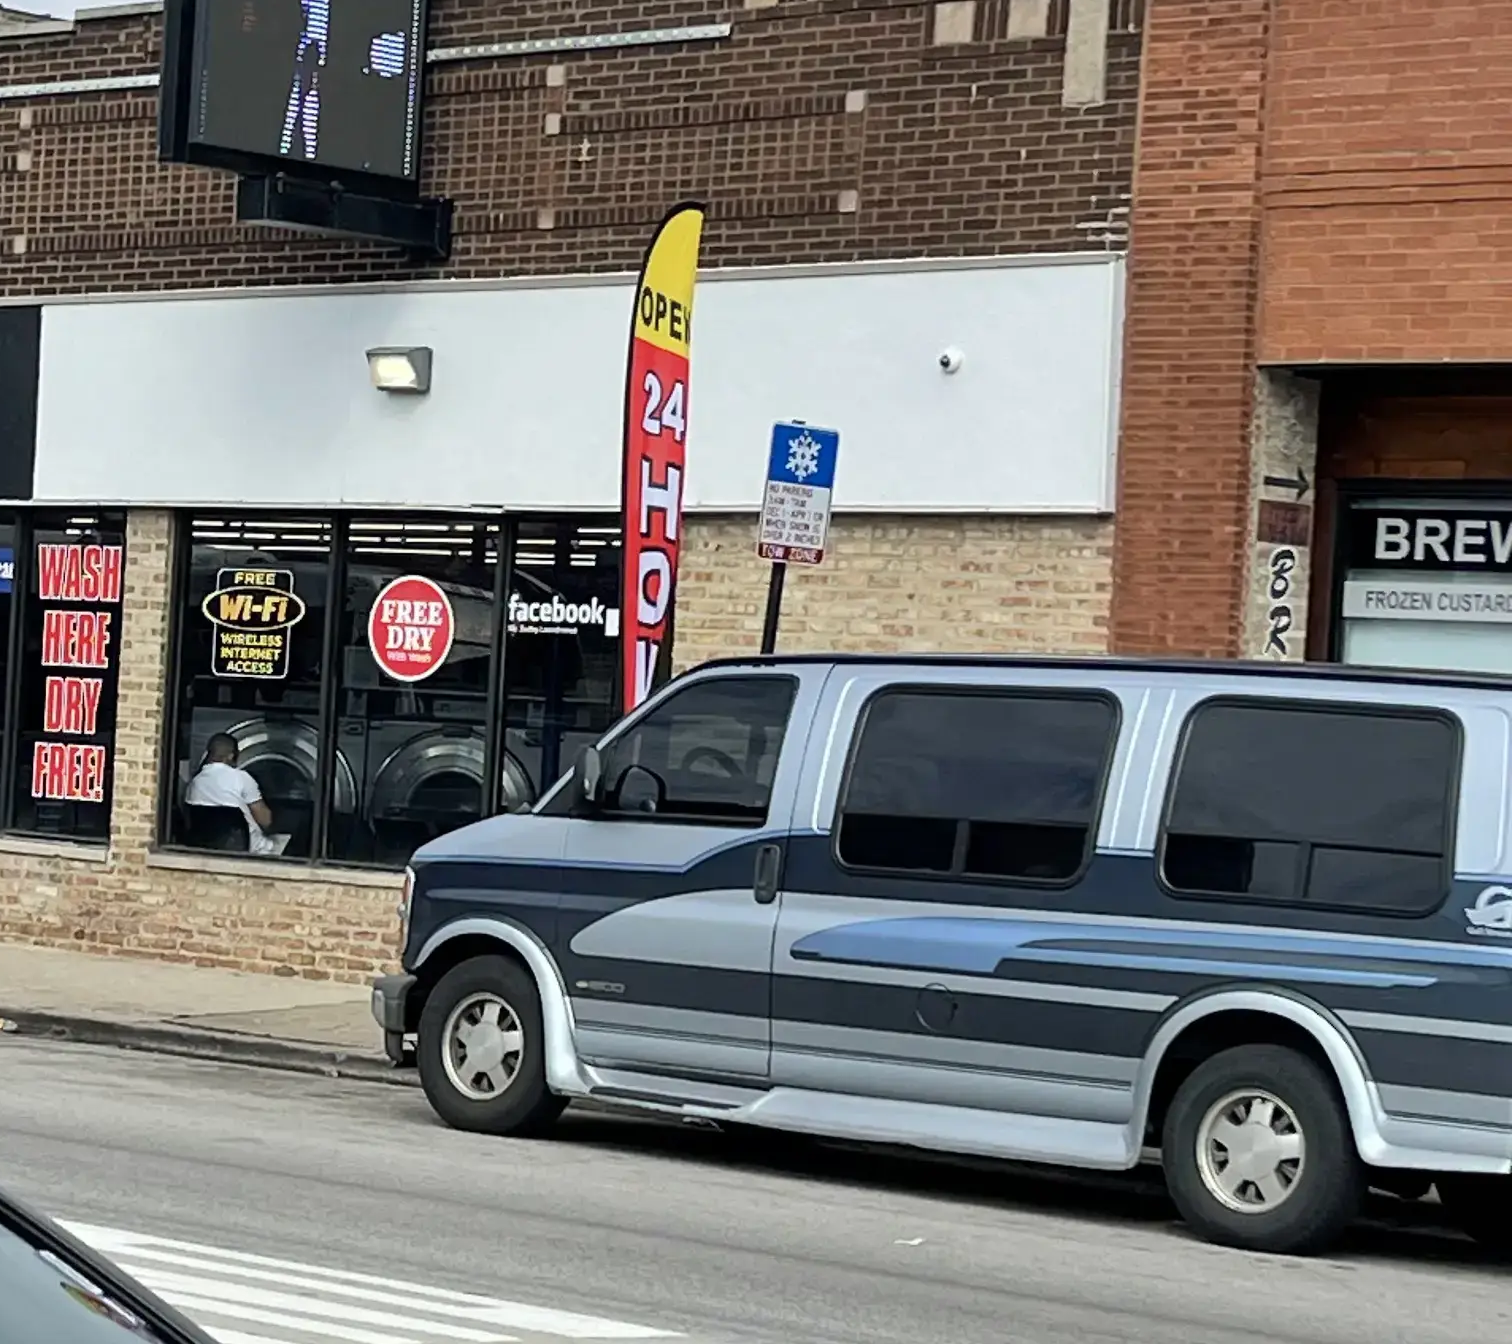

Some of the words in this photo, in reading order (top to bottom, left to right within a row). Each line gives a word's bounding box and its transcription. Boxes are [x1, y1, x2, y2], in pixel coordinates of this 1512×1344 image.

[641, 370, 686, 441] 24
[39, 544, 123, 603] WASH
[234, 571, 277, 586] FREE
[380, 599, 444, 626] FREE
[508, 593, 605, 624] facebook
[1365, 590, 1432, 611] FROZEN
[41, 610, 112, 669] HERE
[220, 633, 283, 648] WIRELESS
[385, 625, 437, 651] DRY
[220, 646, 282, 661] INTERNET
[226, 660, 274, 675] ACCESS
[44, 676, 103, 736] DRY
[31, 741, 106, 803] FREE!
